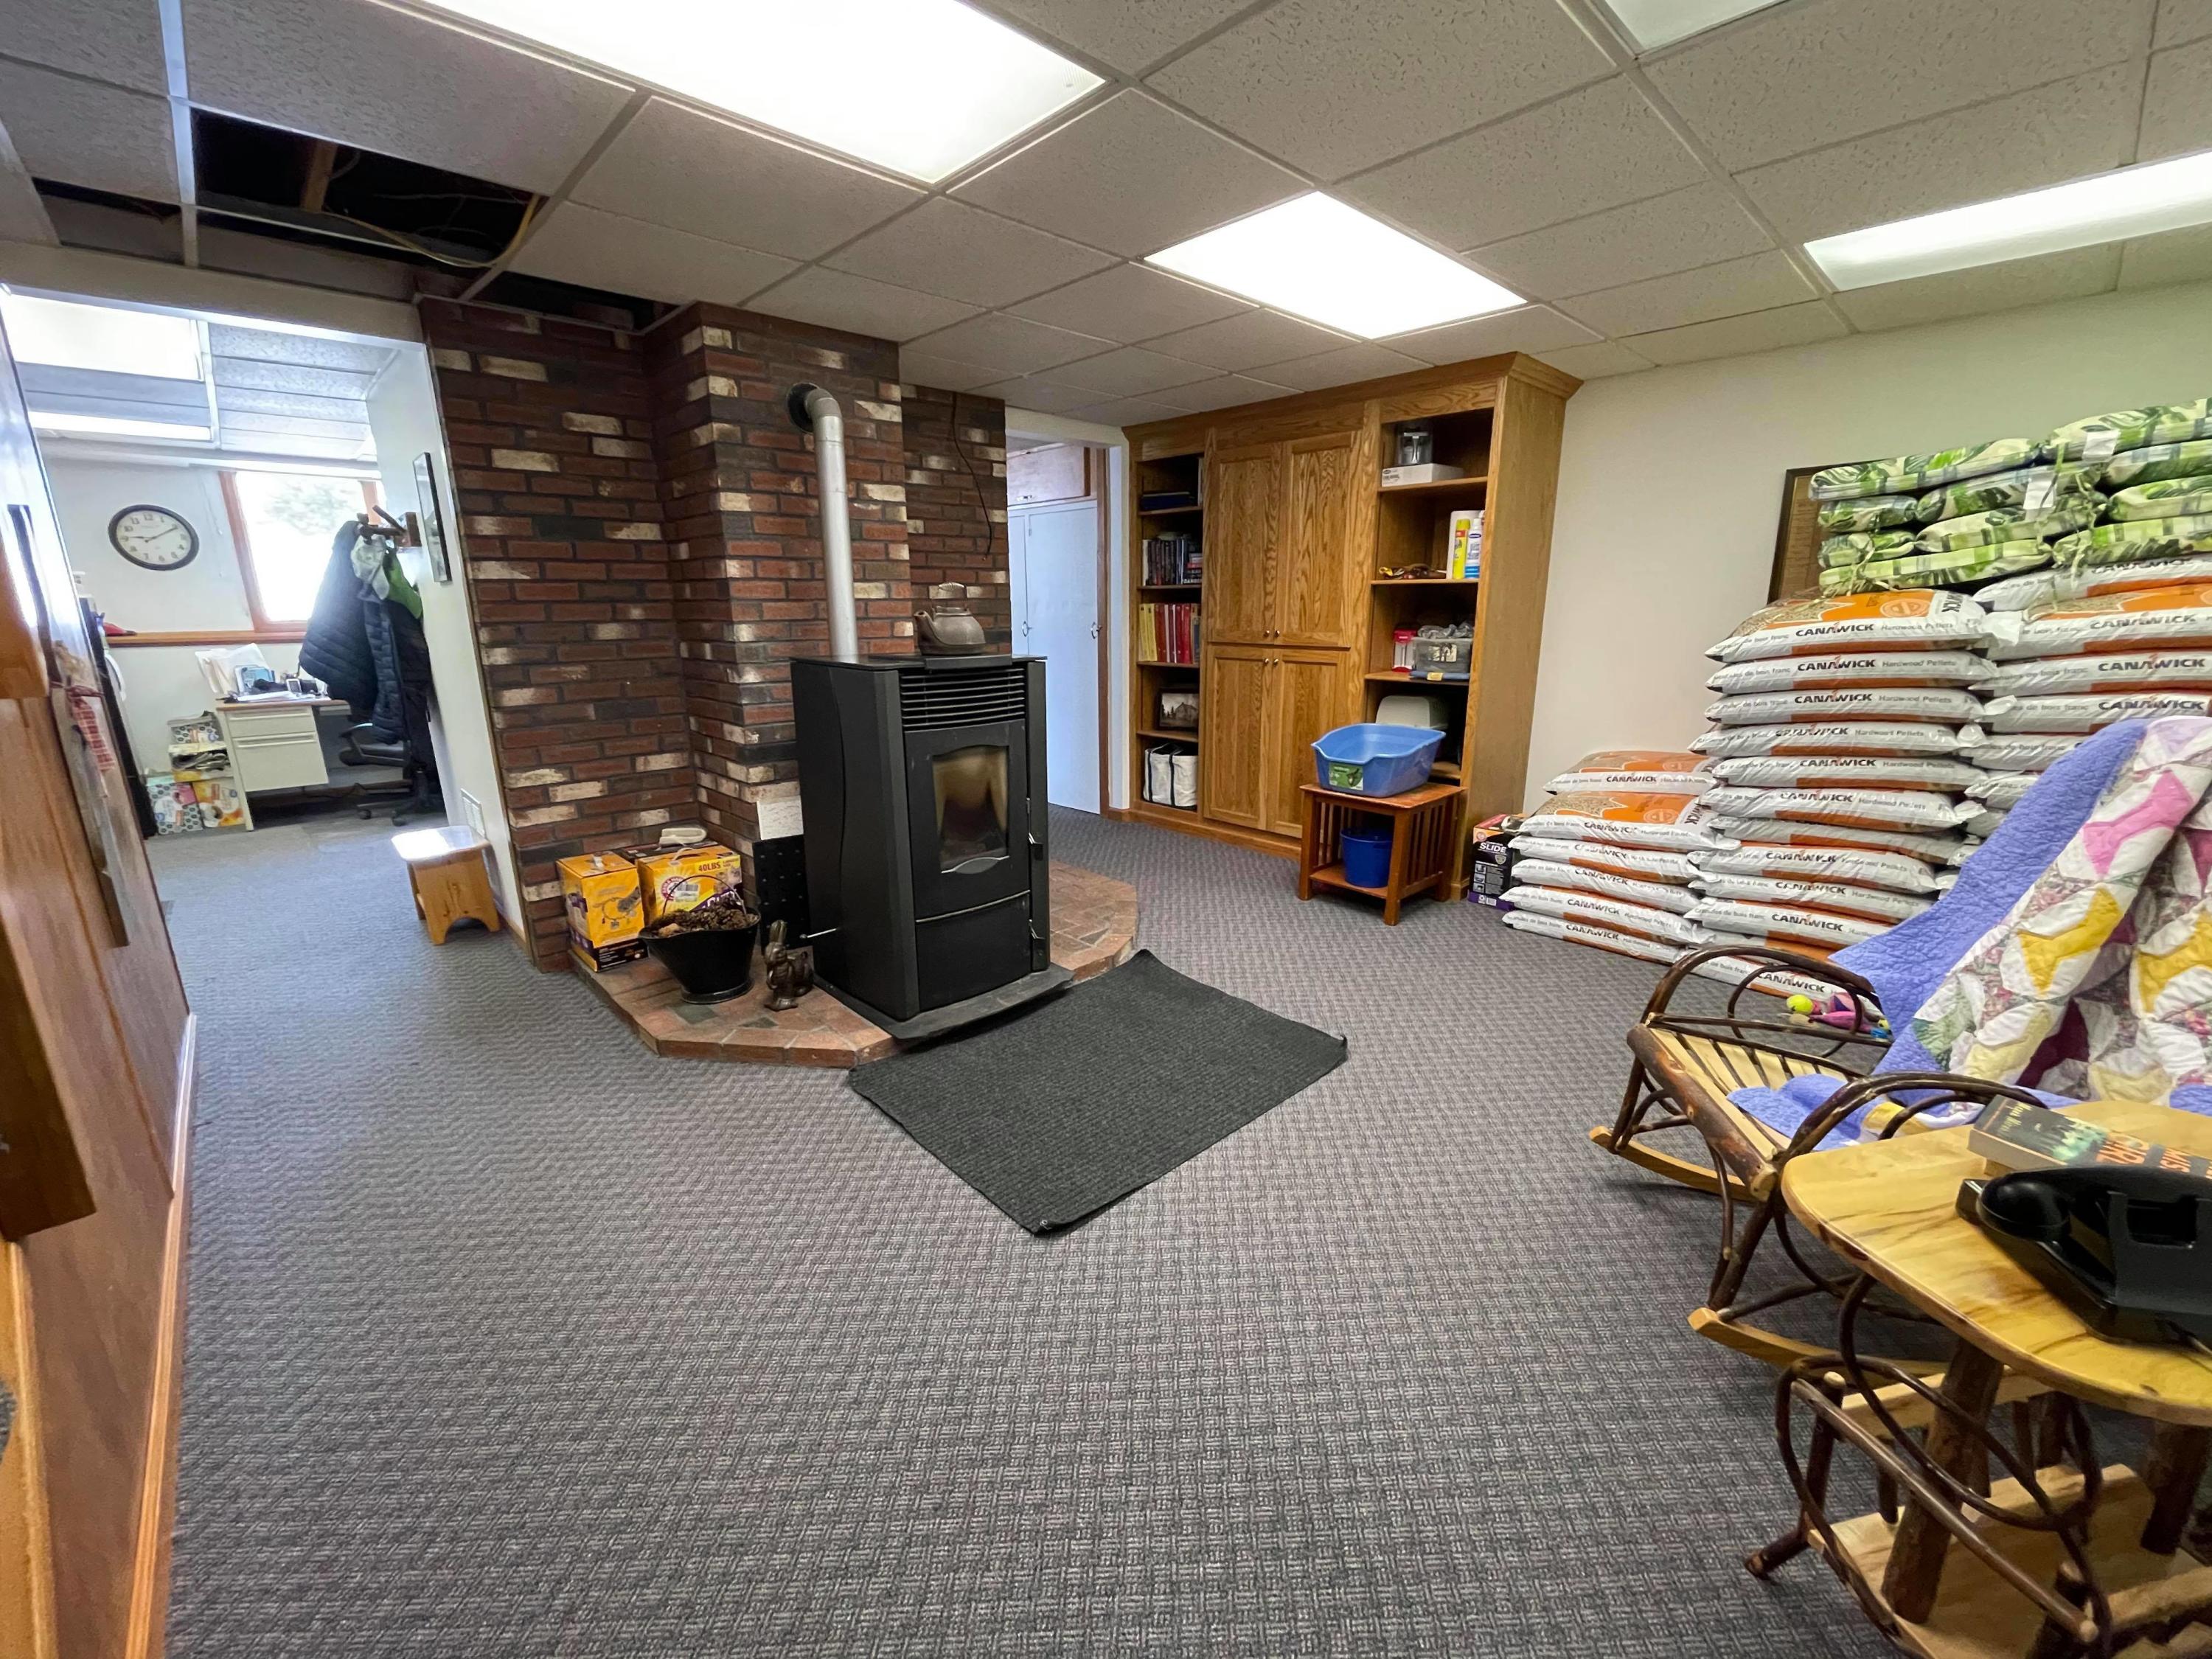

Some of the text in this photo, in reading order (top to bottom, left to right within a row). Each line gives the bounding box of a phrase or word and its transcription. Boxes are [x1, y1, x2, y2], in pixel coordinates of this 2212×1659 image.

[1795, 622, 1874, 637] CANAWICK
[1797, 658, 1877, 672] CANAWICK
[2098, 658, 2205, 672] CANAWICK
[1794, 692, 1874, 705] CANAWICK
[2098, 699, 2205, 711] CANAWICK
[1799, 759, 1877, 768] CANAWICK
[1479, 842, 1507, 854] SLIDE
[698, 861, 721, 872] 40LBS
[1567, 898, 1621, 916] CANAWICK
[1771, 914, 1844, 932] CANAWICK
[2096, 1132, 2150, 1165] GIRL
